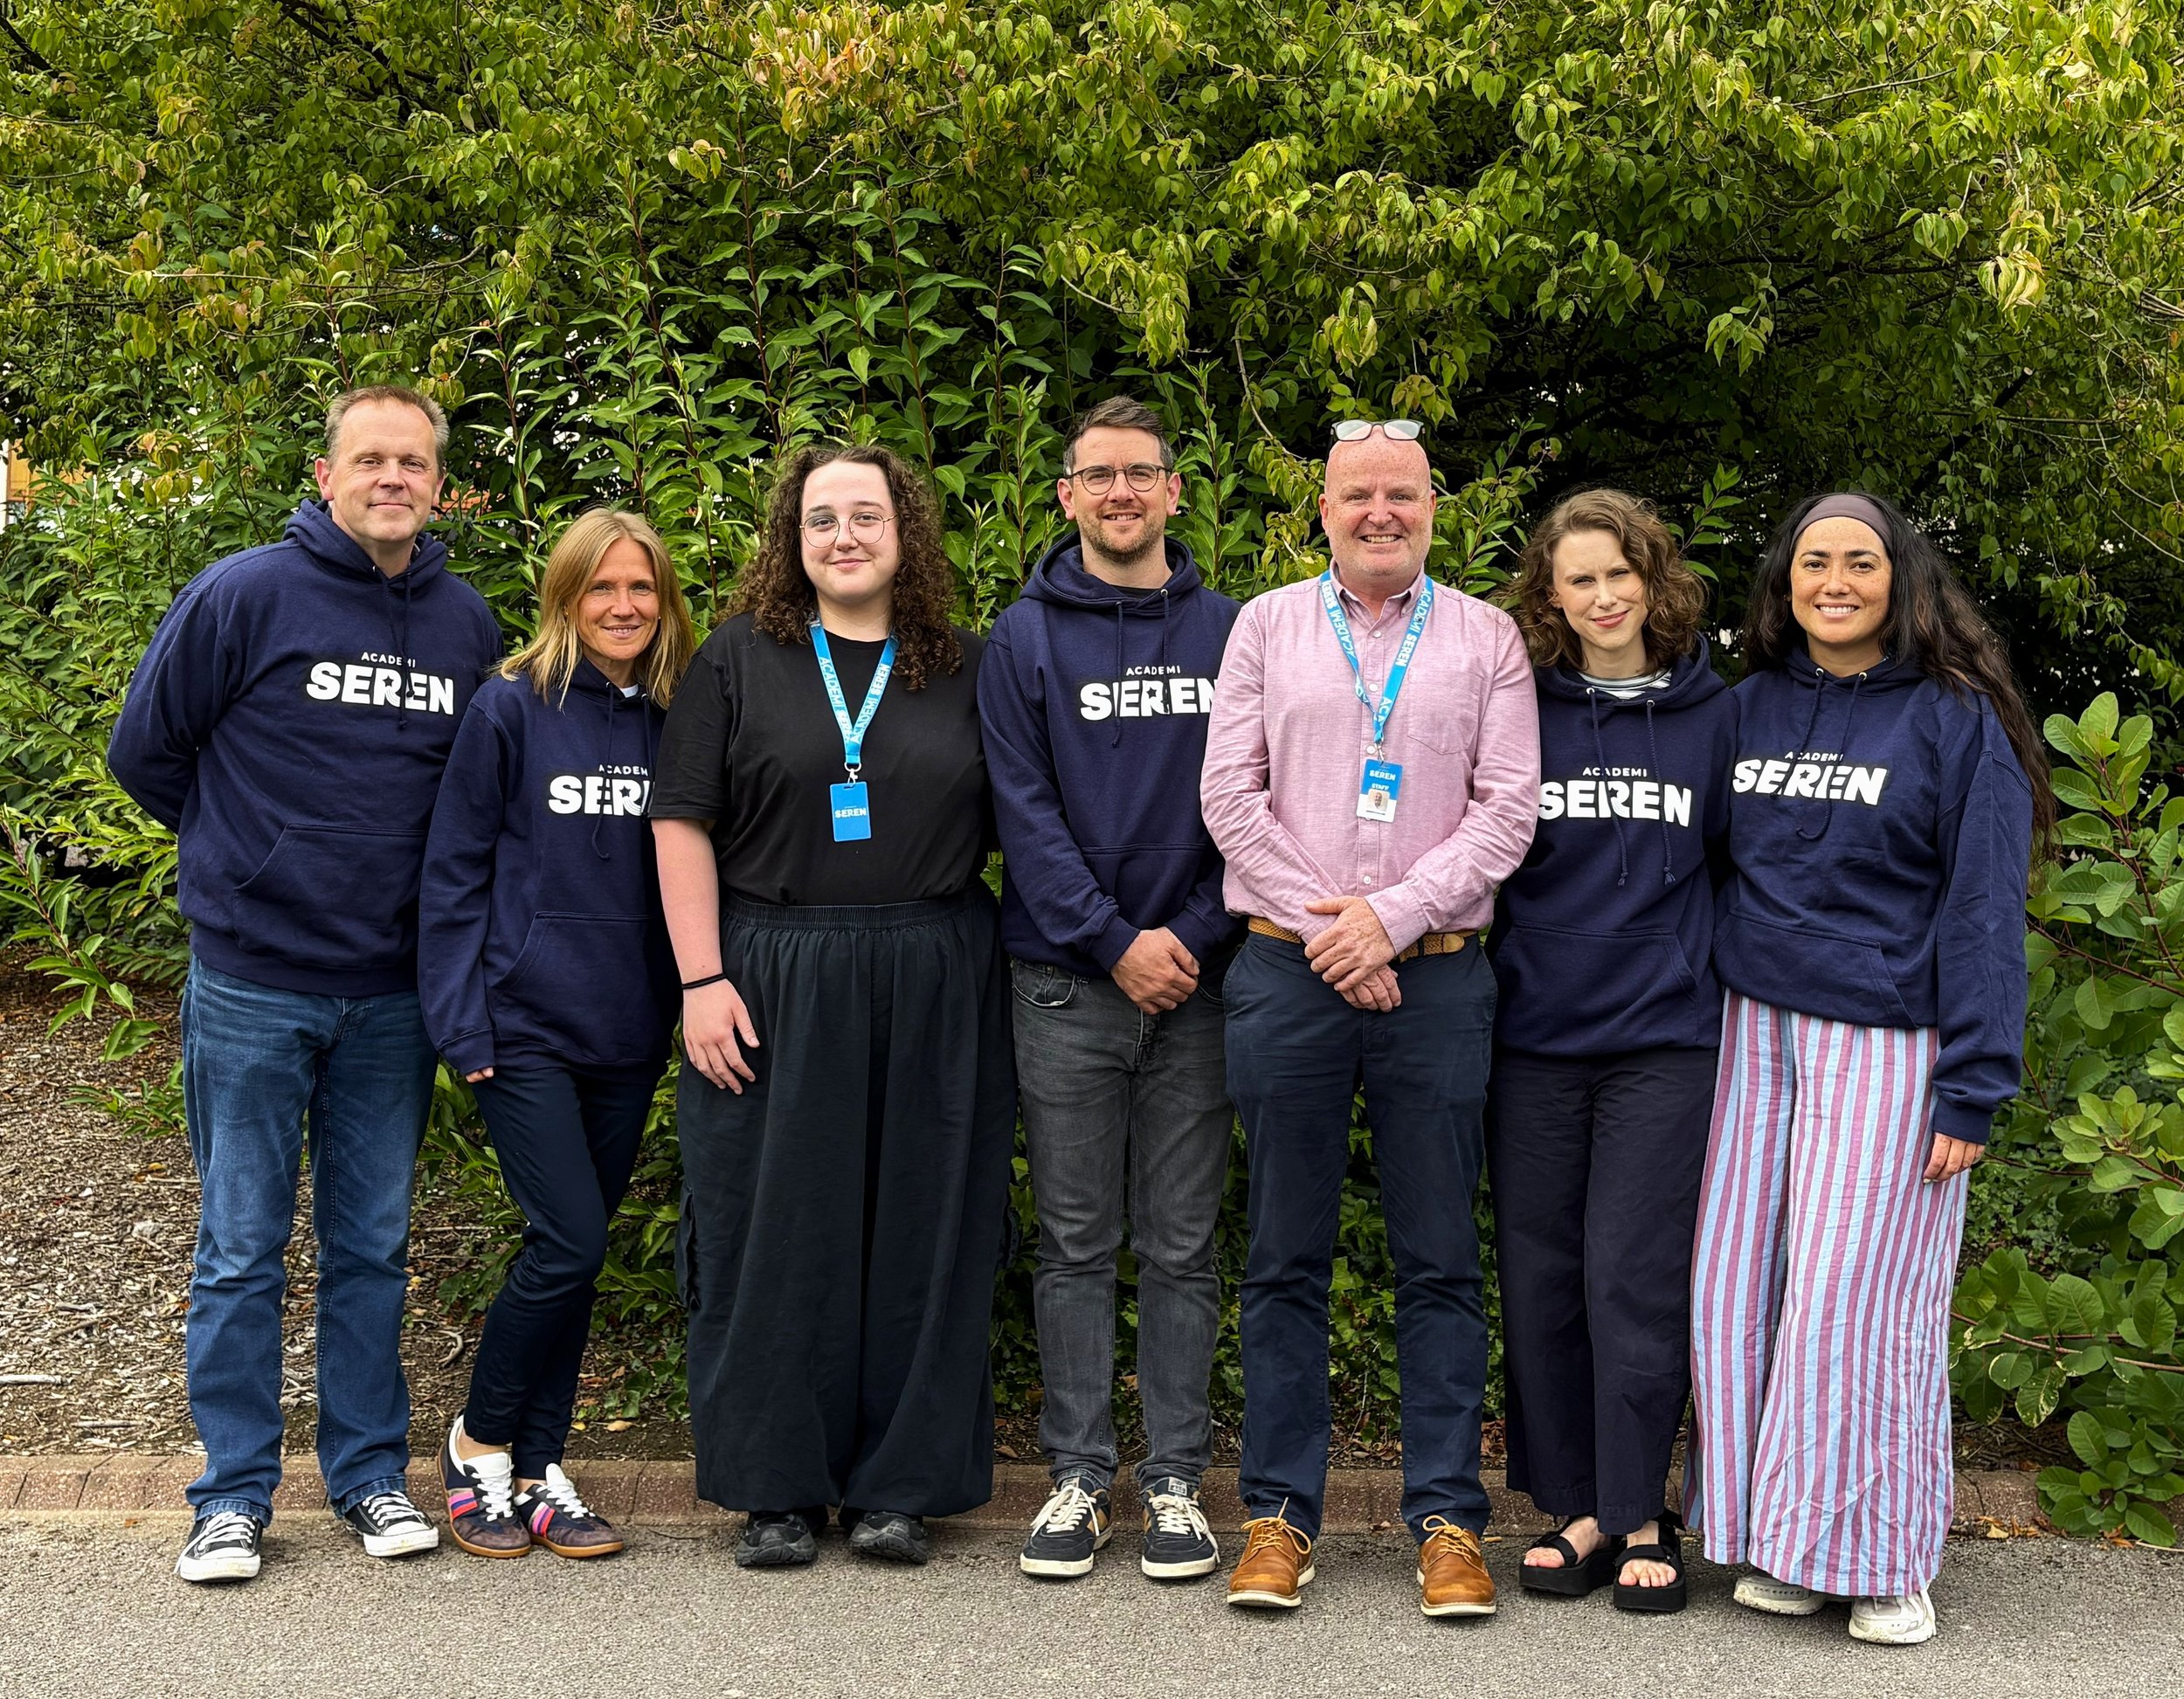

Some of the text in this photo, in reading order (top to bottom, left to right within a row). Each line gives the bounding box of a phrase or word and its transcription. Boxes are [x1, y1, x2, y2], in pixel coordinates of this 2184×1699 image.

[1394, 588, 1433, 667] ACADEMI SEREN
[306, 661, 454, 715] SEREN
[819, 656, 847, 707] ACADEMI
[869, 663, 892, 695] SEREN
[1125, 665, 1181, 676] ACADEMI
[1080, 678, 1218, 721] SEREN
[598, 763, 649, 777] ACADEM
[1369, 770, 1396, 781] SEREN
[1732, 759, 1888, 806] SEREN
[834, 808, 867, 818] SEREN
[1538, 780, 1692, 828] SEREN
